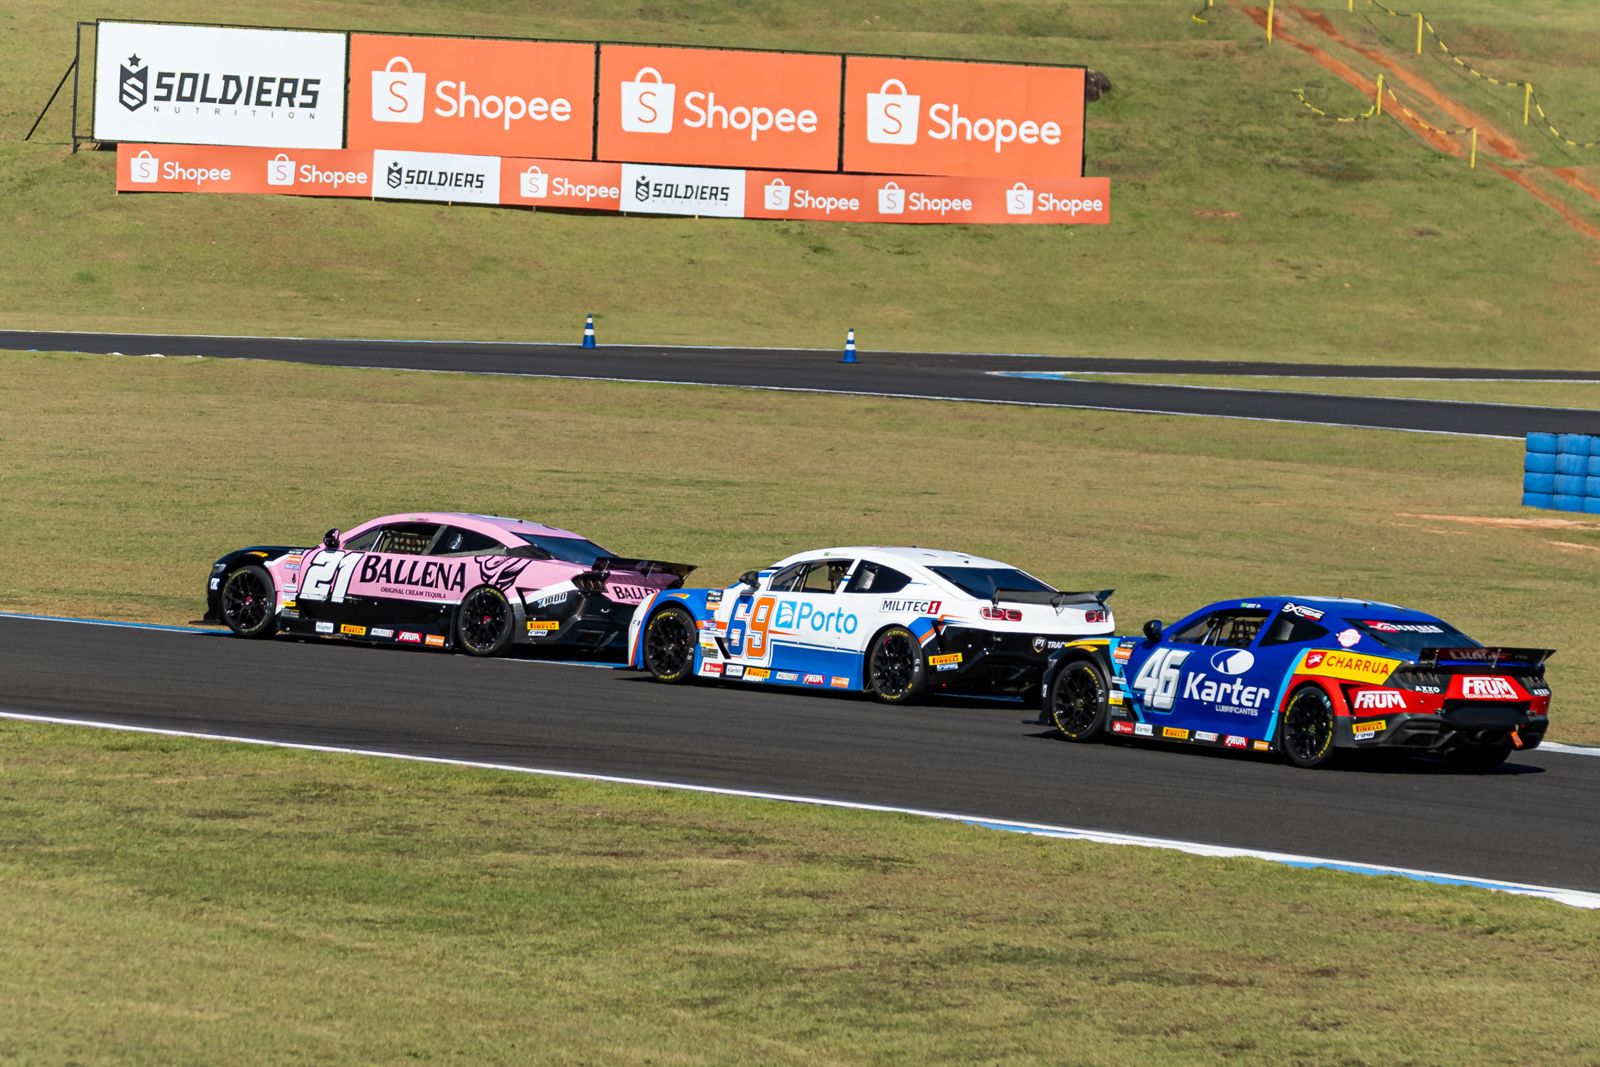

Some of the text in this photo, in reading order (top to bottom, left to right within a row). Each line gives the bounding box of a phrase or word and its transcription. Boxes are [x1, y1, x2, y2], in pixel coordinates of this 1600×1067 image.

[154, 72, 321, 108] SOLDIERS
[154, 106, 315, 119] NUTRITION
[434, 80, 572, 130] Shopee
[683, 91, 818, 141] Shopee
[928, 103, 1062, 153] Shopee
[163, 162, 232, 185] Shopee
[299, 165, 368, 188] Shopee
[405, 170, 485, 189] SOLDIERS
[552, 177, 619, 202] Shopee
[652, 183, 730, 201] SOLDIERS
[793, 190, 860, 214] Shopee
[909, 192, 973, 215] Shopee
[1037, 193, 1104, 216] Shopee
[298, 550, 364, 603] 21
[359, 555, 466, 593] BALLENA
[381, 586, 405, 595] ORIGINAL
[424, 591, 446, 599] TEQUILA
[727, 595, 776, 658] 69
[796, 602, 858, 634] Porto
[1326, 656, 1389, 676] CHARRUA
[1133, 648, 1191, 710] 46
[1183, 671, 1270, 708] Karter
[1415, 685, 1440, 694] AXXO
[1463, 677, 1517, 695] FRUM
[1354, 689, 1407, 708] FRUM
[1215, 705, 1259, 717] LUBRIFICANTES
